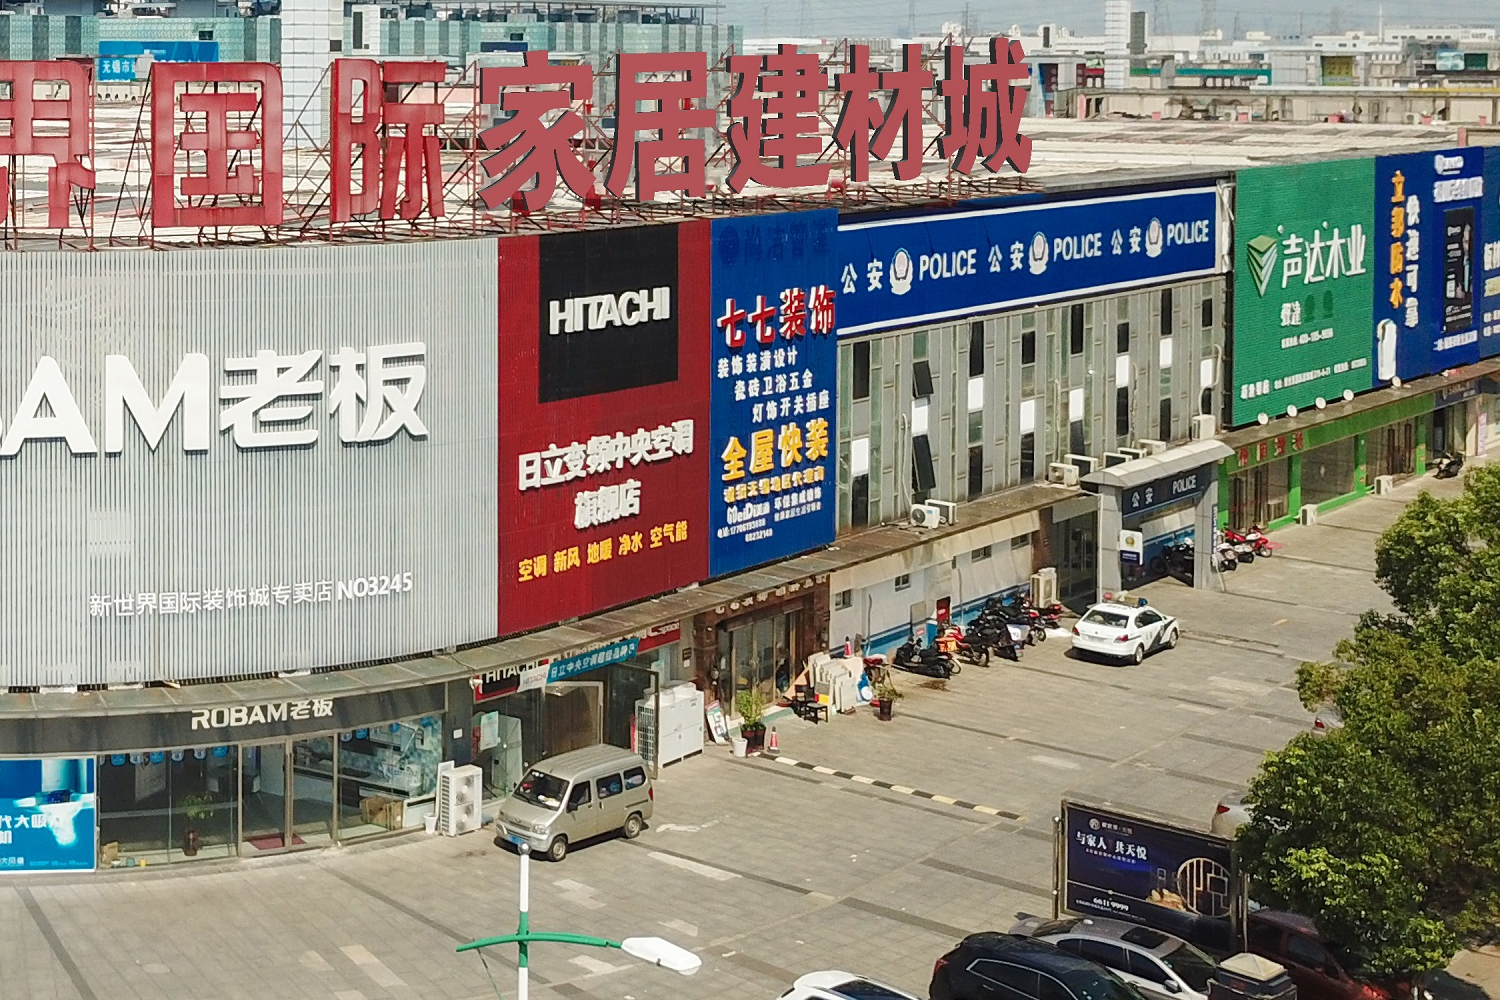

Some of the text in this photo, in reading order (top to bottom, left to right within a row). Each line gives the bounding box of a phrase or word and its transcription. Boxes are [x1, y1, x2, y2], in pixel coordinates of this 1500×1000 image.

[102, 59, 136, 74] 无锡市
[841, 217, 1210, 295] 公安 POLICE 公安 POLICE 公安 POLICE
[1281, 222, 1367, 290] 声达木业
[548, 286, 671, 336] HITACHI
[716, 284, 837, 348] 七七装饰
[518, 418, 695, 492] 日立变频中央空调
[720, 417, 829, 482] 全屋快装
[574, 479, 642, 530] 旗舰店
[1172, 474, 1198, 495] POLICE
[518, 553, 548, 583] 空调
[553, 542, 581, 573] 新风
[618, 529, 644, 556] 净水
[649, 519, 689, 550] 空气能
[88, 570, 414, 618] 新世界国际装饰城专卖店 NO3245
[1075, 830, 1108, 851] 与家人
